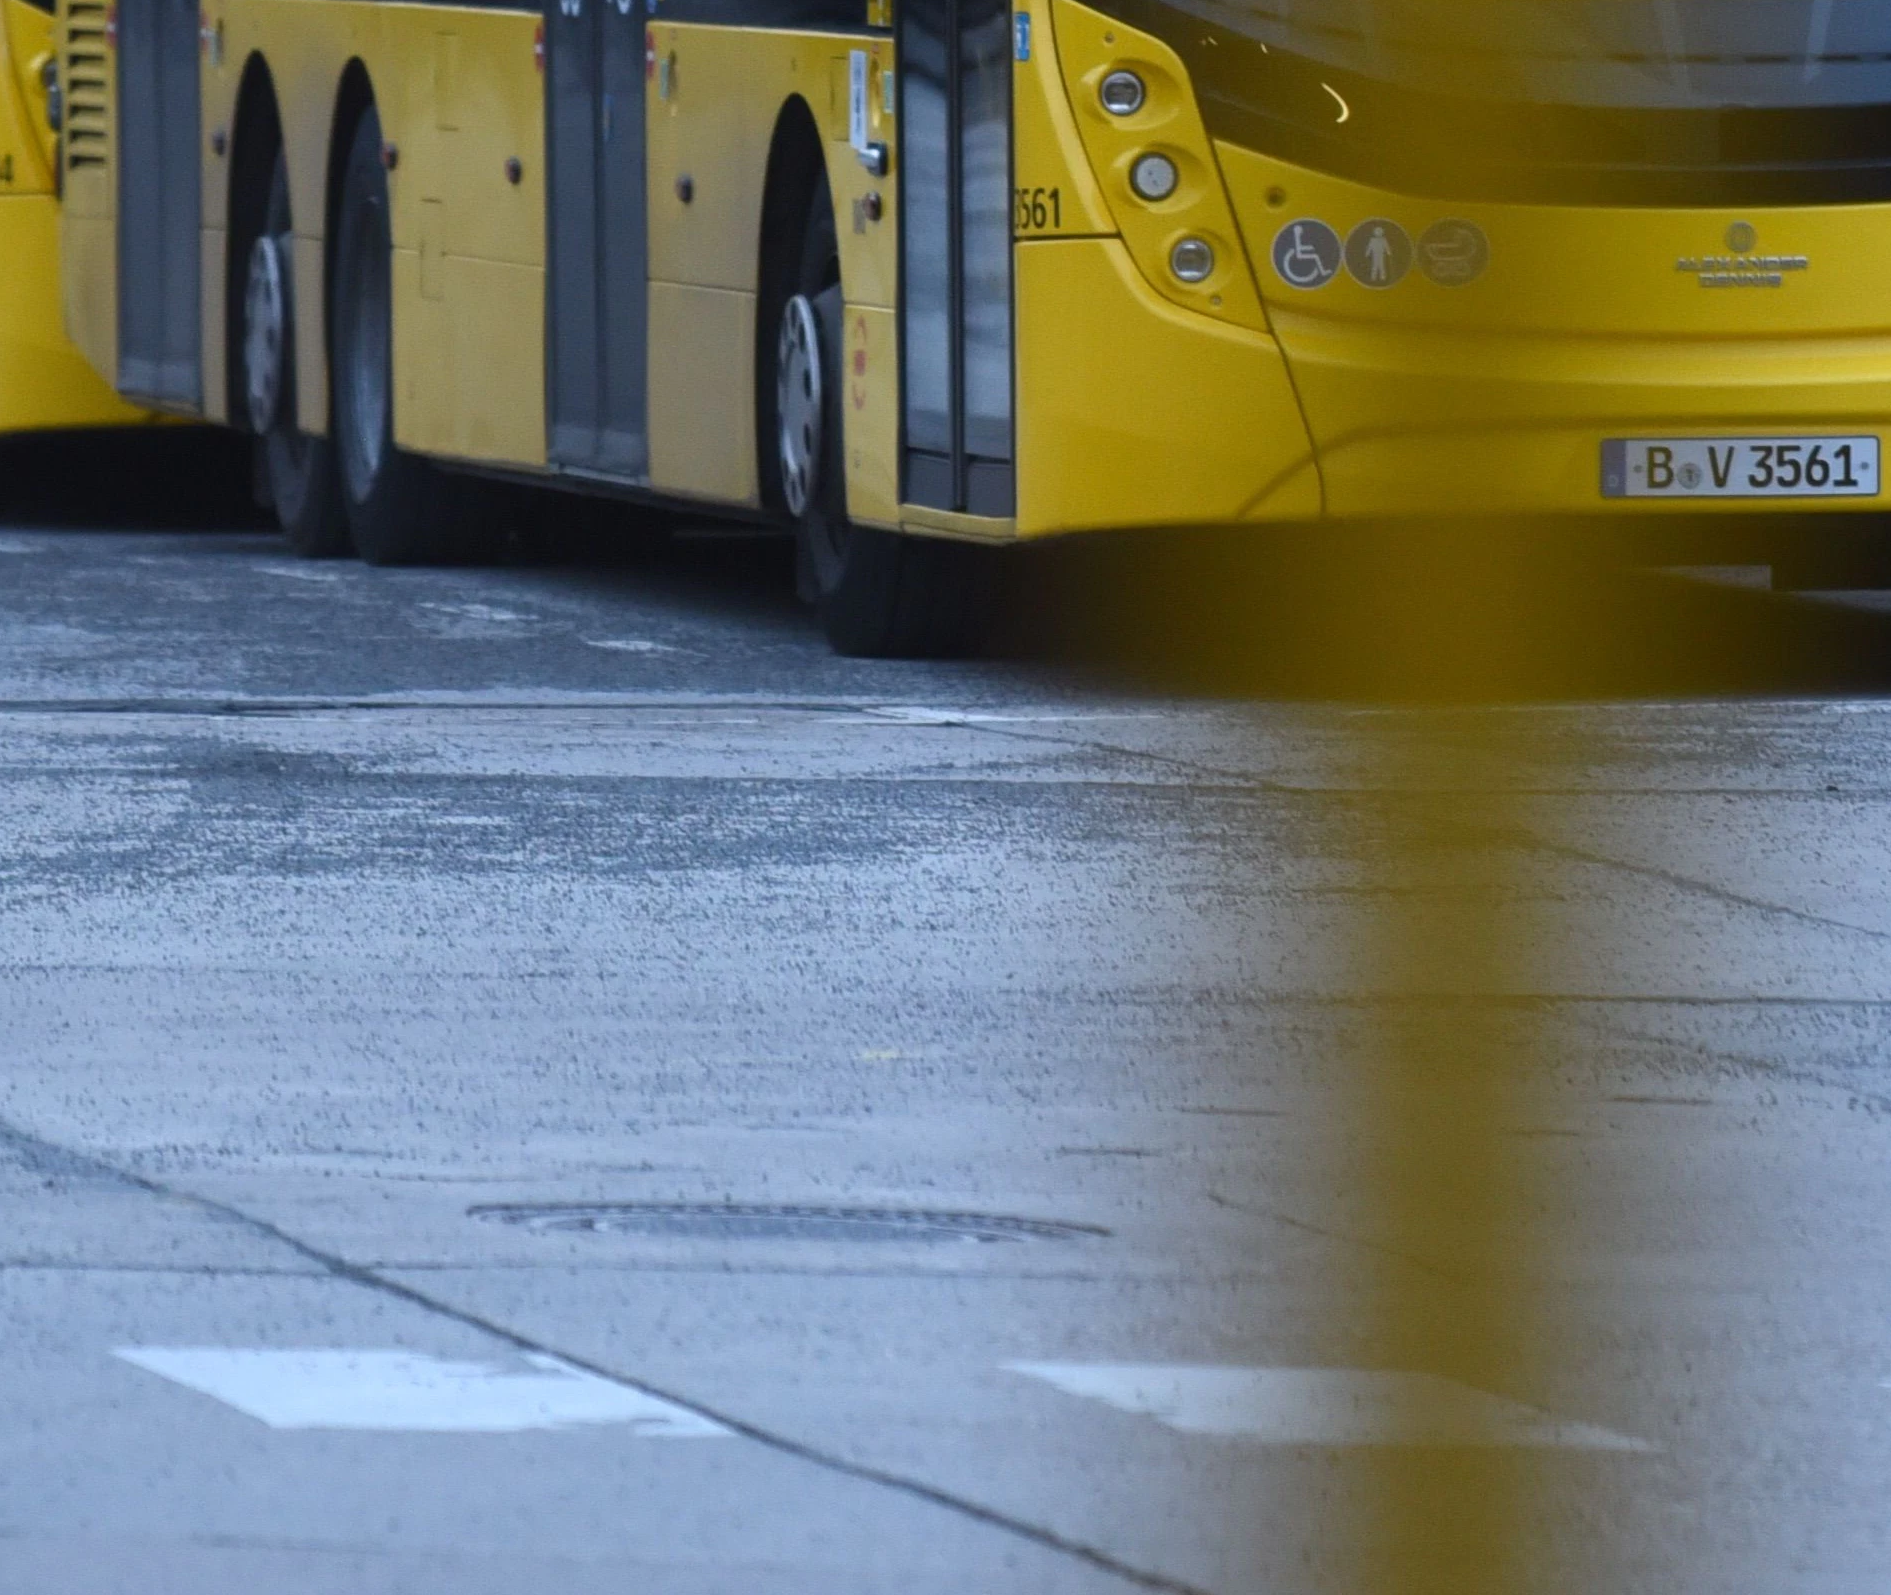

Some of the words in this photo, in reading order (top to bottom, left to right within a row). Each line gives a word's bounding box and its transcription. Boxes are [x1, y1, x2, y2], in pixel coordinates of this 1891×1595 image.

[1015, 187, 1060, 230] 561
[1646, 446, 1674, 488] B
[1708, 446, 1734, 488] V
[1747, 445, 1858, 488] 3561
